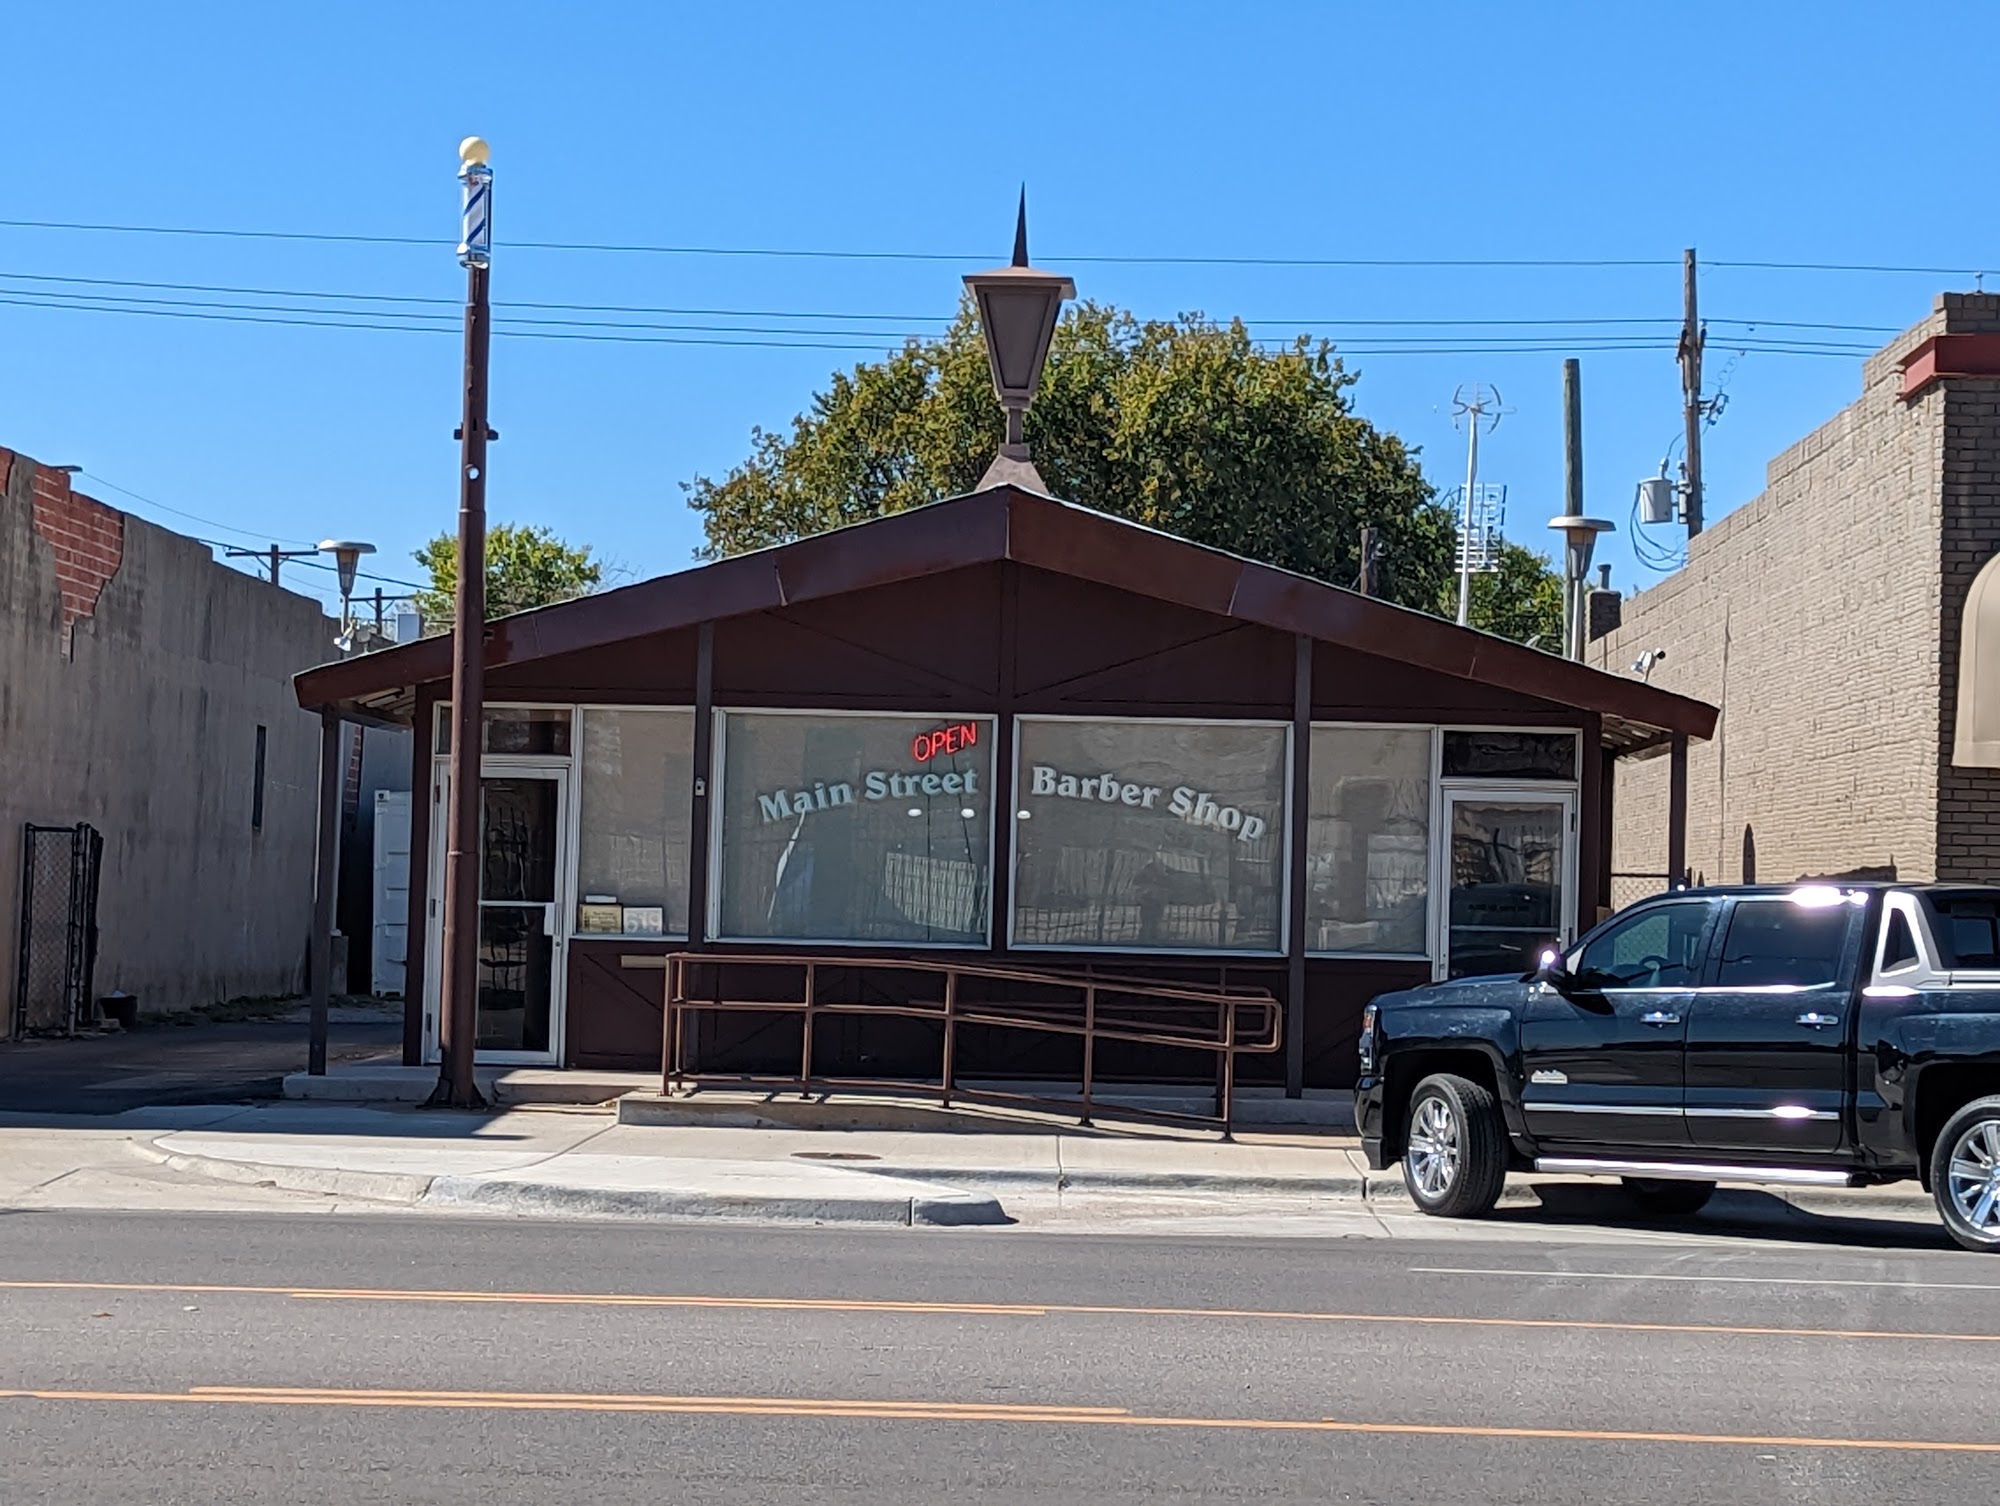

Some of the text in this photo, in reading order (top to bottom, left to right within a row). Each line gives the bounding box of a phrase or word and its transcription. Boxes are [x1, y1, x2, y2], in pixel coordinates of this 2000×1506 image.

[912, 722, 978, 762] OPEN
[757, 766, 1266, 842] Main Street Barber Shop
